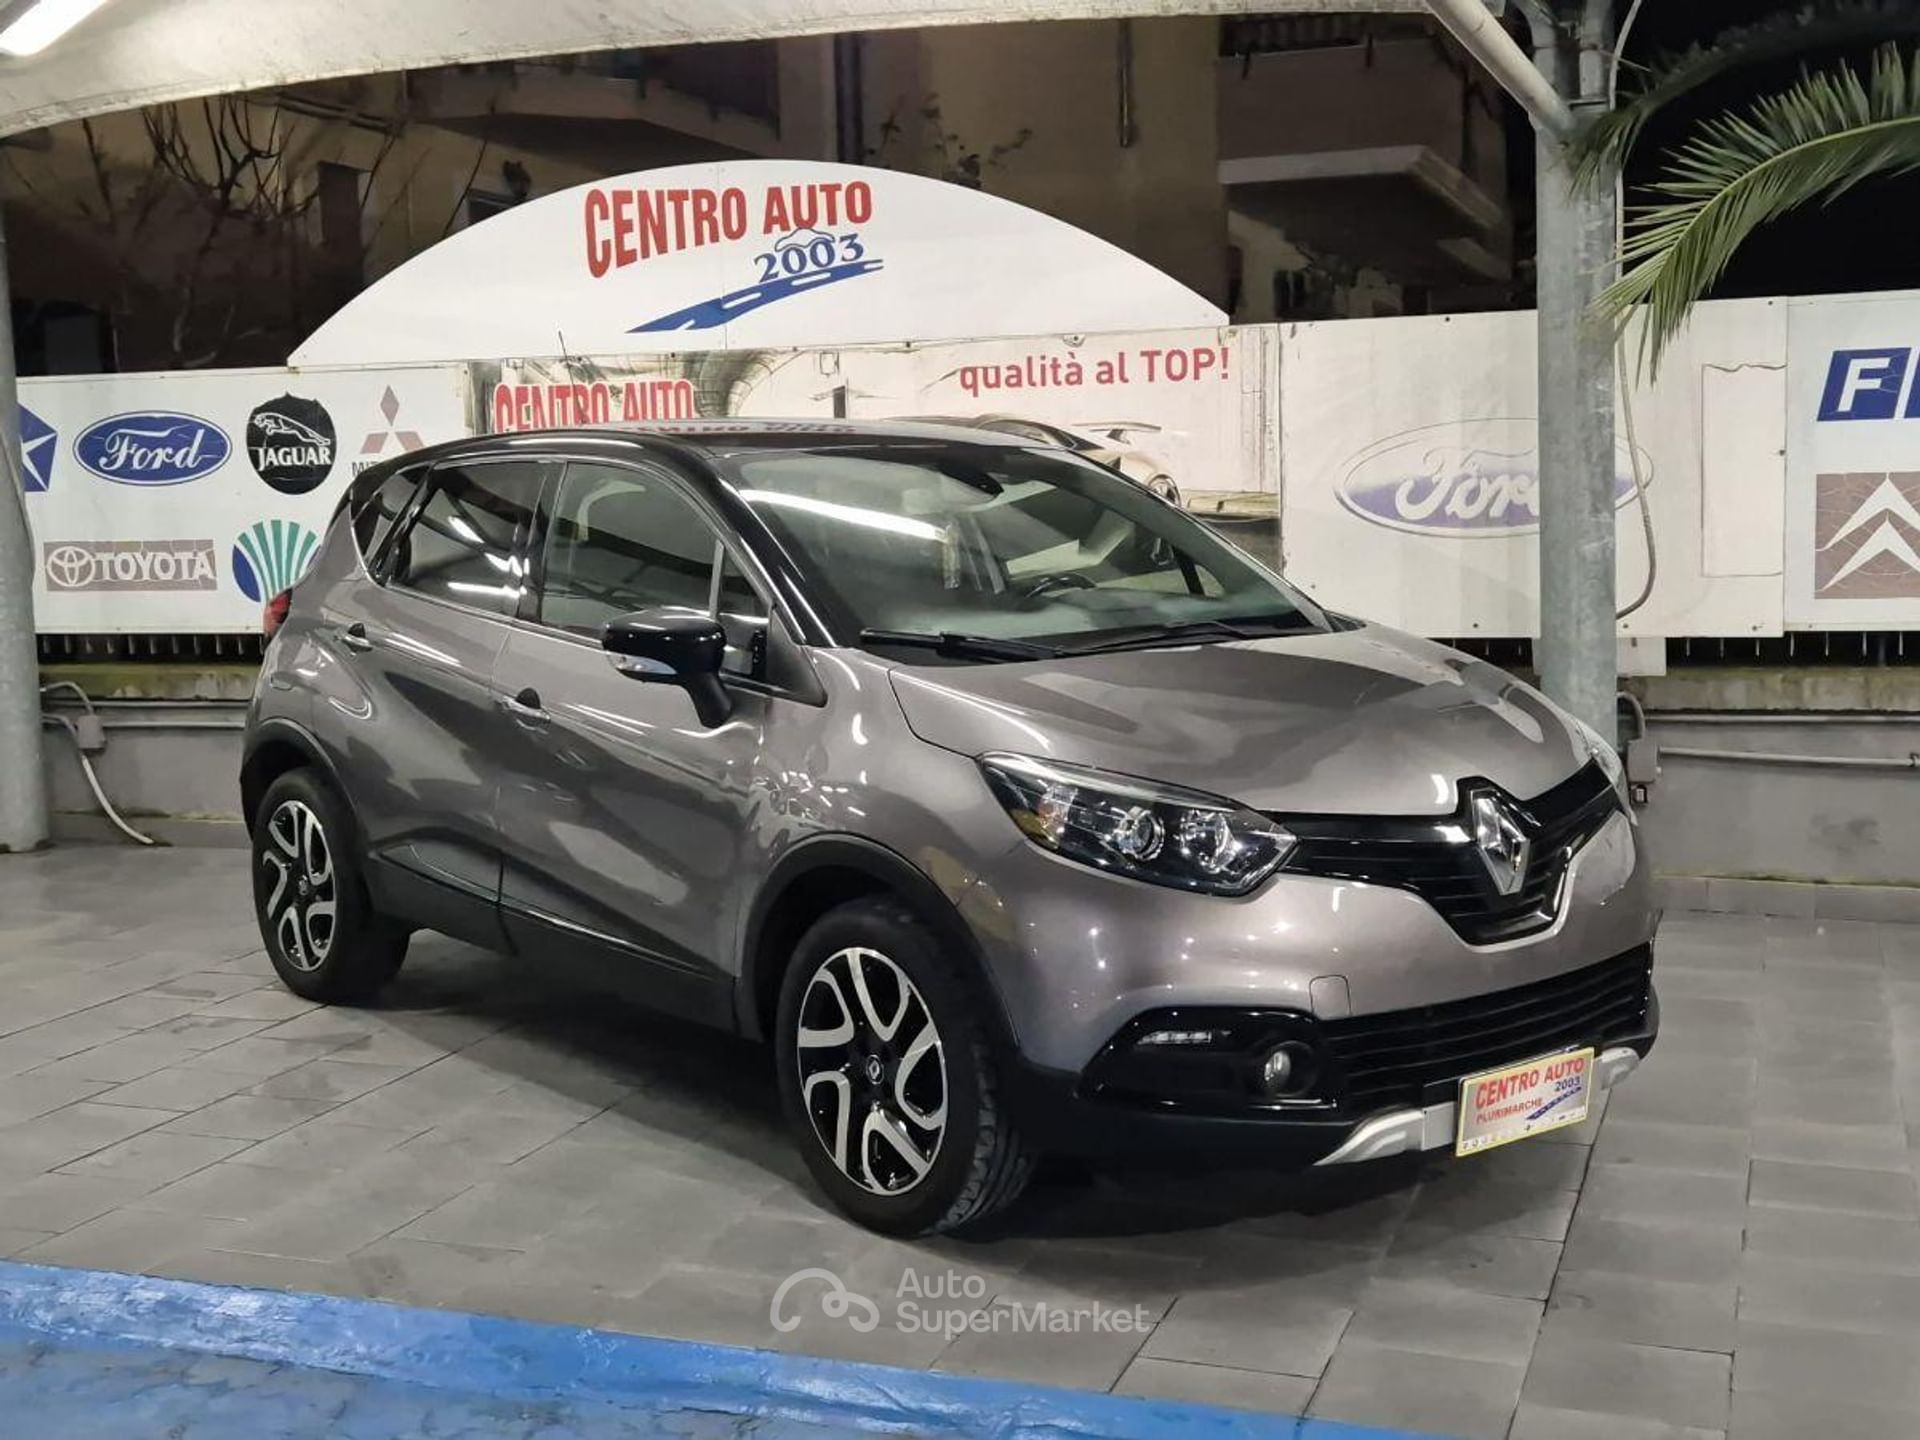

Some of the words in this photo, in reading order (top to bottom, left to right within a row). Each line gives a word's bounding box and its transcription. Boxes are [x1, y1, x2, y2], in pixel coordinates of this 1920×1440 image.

[584, 187, 748, 278] CENTRO
[763, 180, 872, 235] AUTO
[753, 233, 864, 284] 2003
[959, 351, 1083, 398] qualità
[1096, 351, 1129, 384] al
[1140, 347, 1229, 383] TOP!
[495, 383, 610, 434] CENTRO
[623, 381, 692, 421] AUTO
[100, 425, 205, 470] Ford
[258, 447, 332, 472] JAGUAR
[1394, 447, 1540, 521] For
[96, 551, 217, 580] TOYOTA
[1474, 1070, 1540, 1109] CENTRO
[1543, 1057, 1585, 1084] AUTO
[1554, 1075, 1581, 1093] 2003
